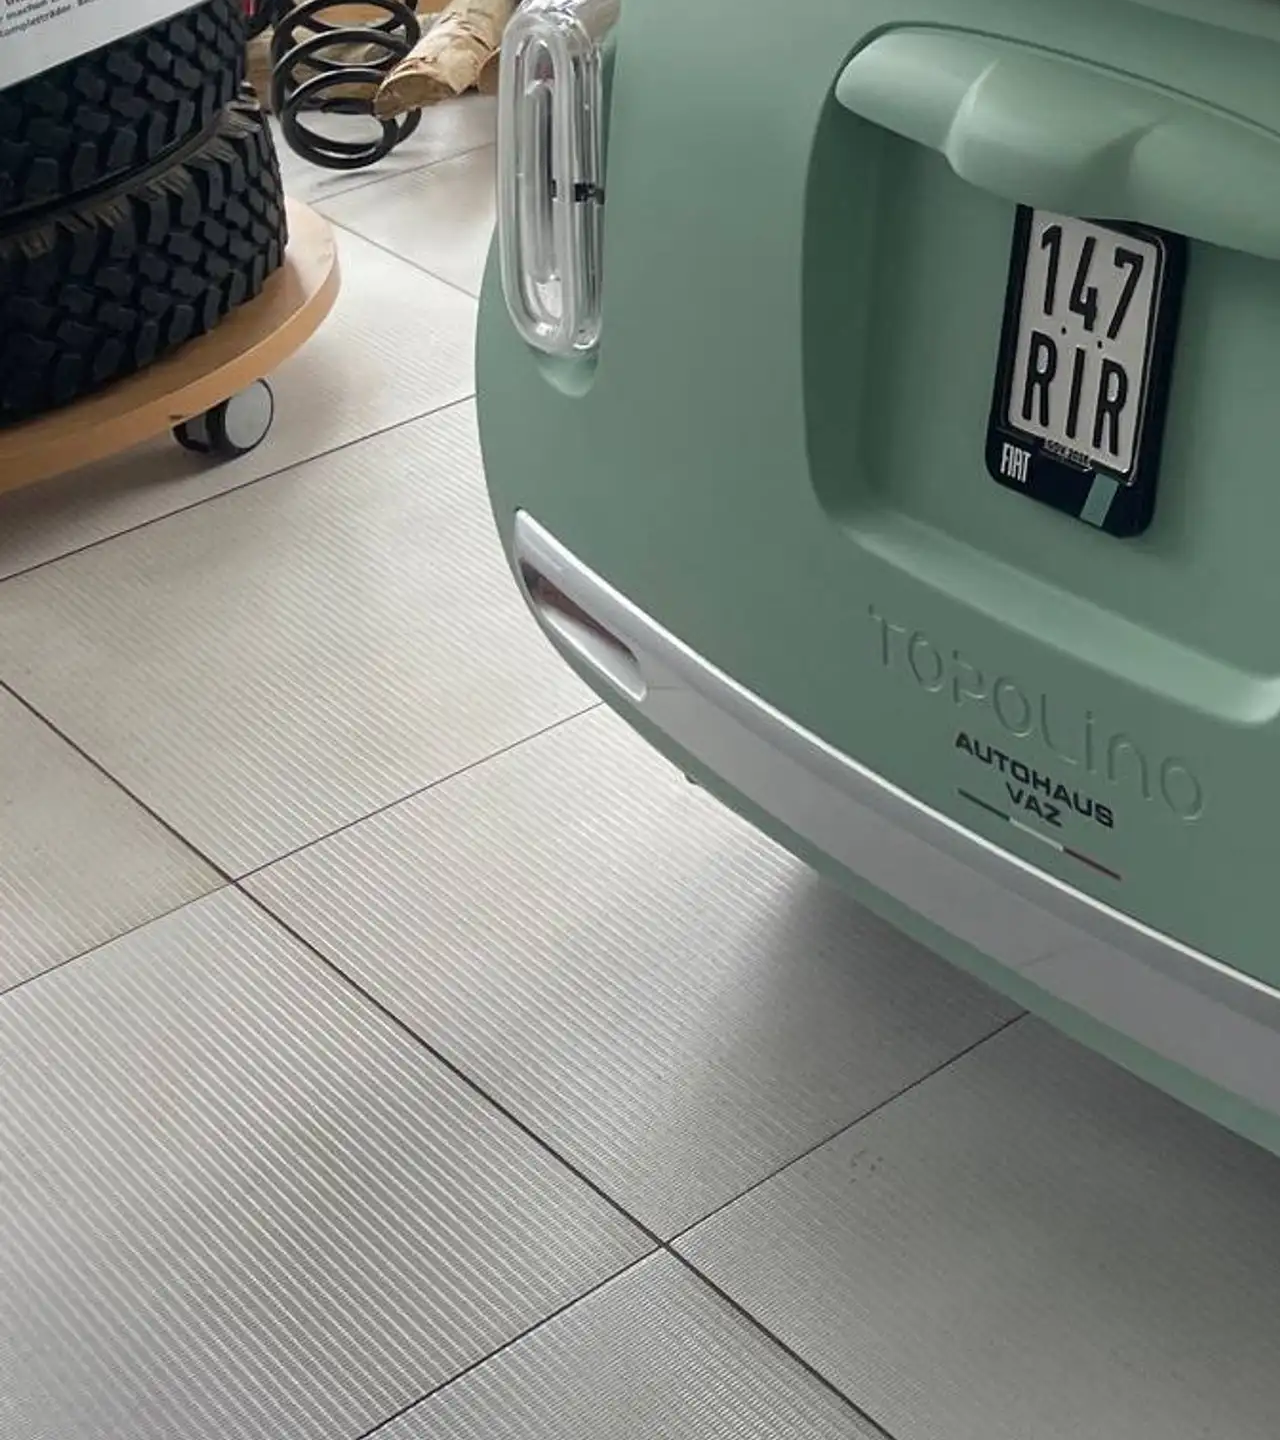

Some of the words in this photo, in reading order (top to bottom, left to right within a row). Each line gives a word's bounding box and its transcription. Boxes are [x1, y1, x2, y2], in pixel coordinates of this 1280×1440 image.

[1041, 224, 1144, 341] 147
[1021, 329, 1128, 457] RIR
[1001, 442, 1032, 484] FIAT
[956, 731, 1114, 829] AUTOHAUS
[1005, 780, 1062, 828] VAZ
